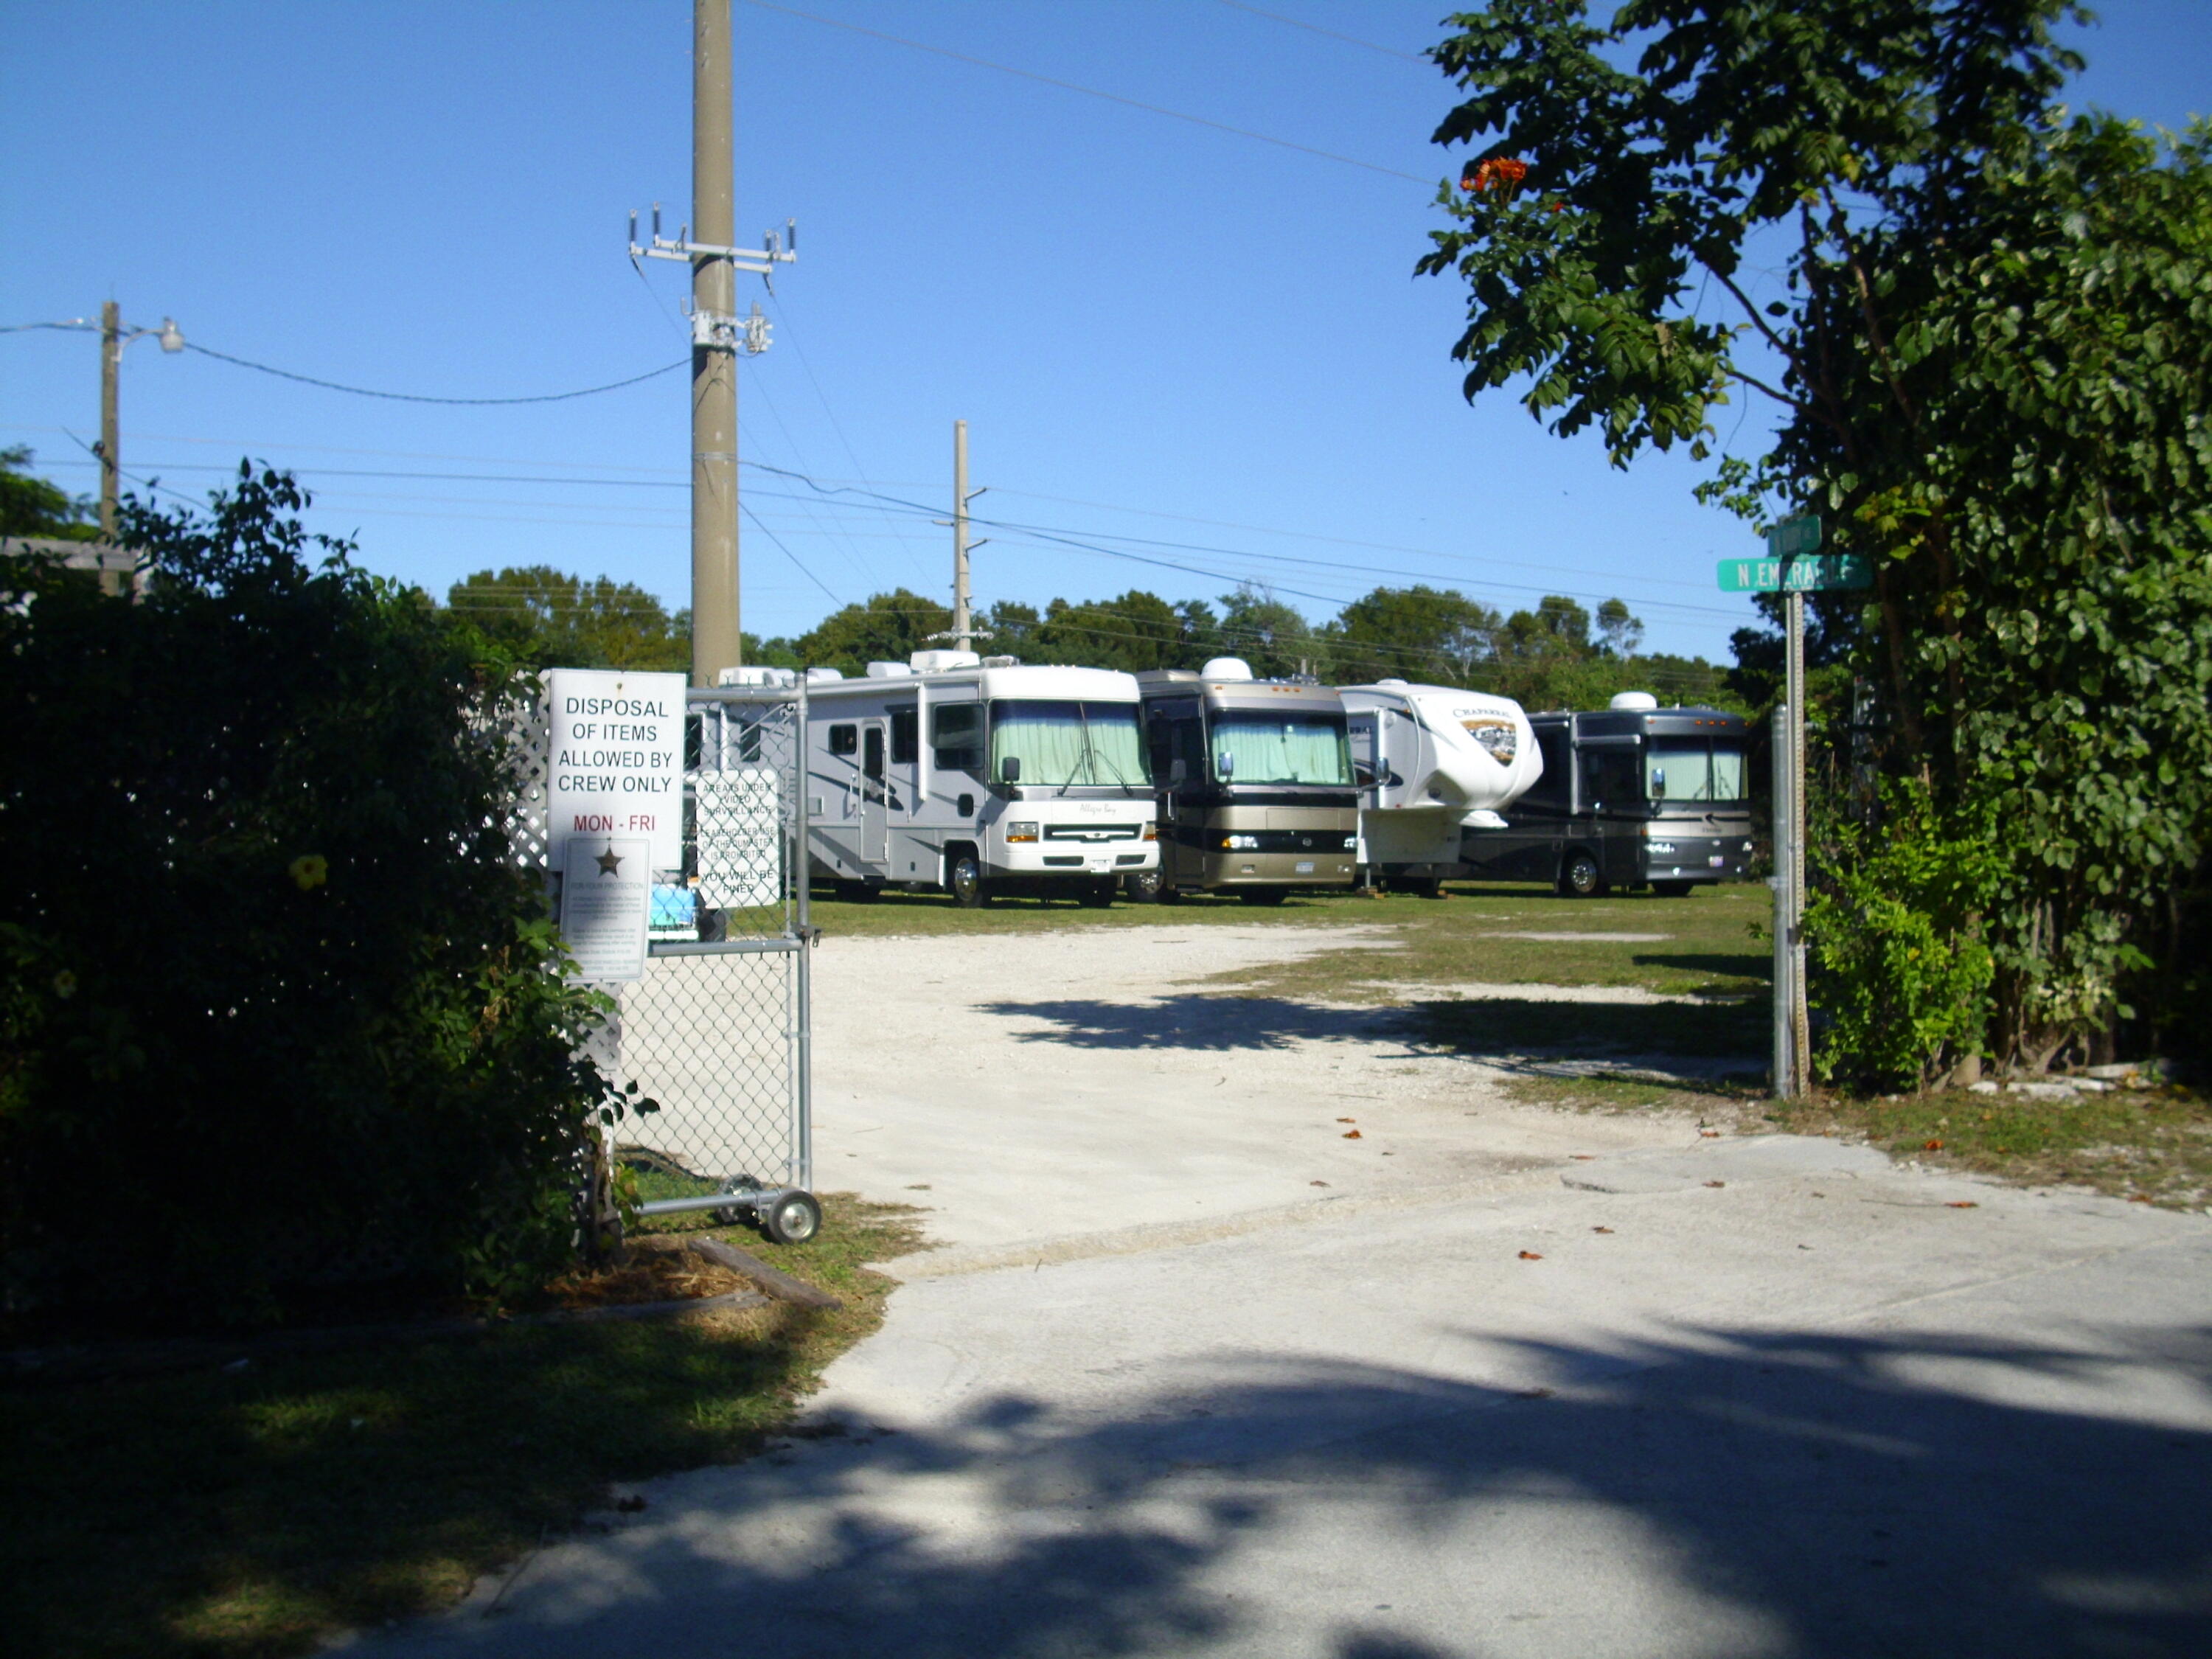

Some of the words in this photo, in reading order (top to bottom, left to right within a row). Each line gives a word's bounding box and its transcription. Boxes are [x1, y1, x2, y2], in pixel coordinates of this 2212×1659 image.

[1737, 563, 1750, 587] N
[566, 697, 669, 717] DISPOSAL
[573, 723, 597, 740] OF
[603, 723, 657, 742] ITEMS
[558, 750, 645, 768] ALLOWED
[650, 751, 672, 768] BY
[558, 775, 616, 792] CREW
[622, 776, 672, 793] ONLY
[574, 815, 613, 832] MON
[629, 815, 655, 831] FRI
[732, 837, 773, 847] DUMSTE
